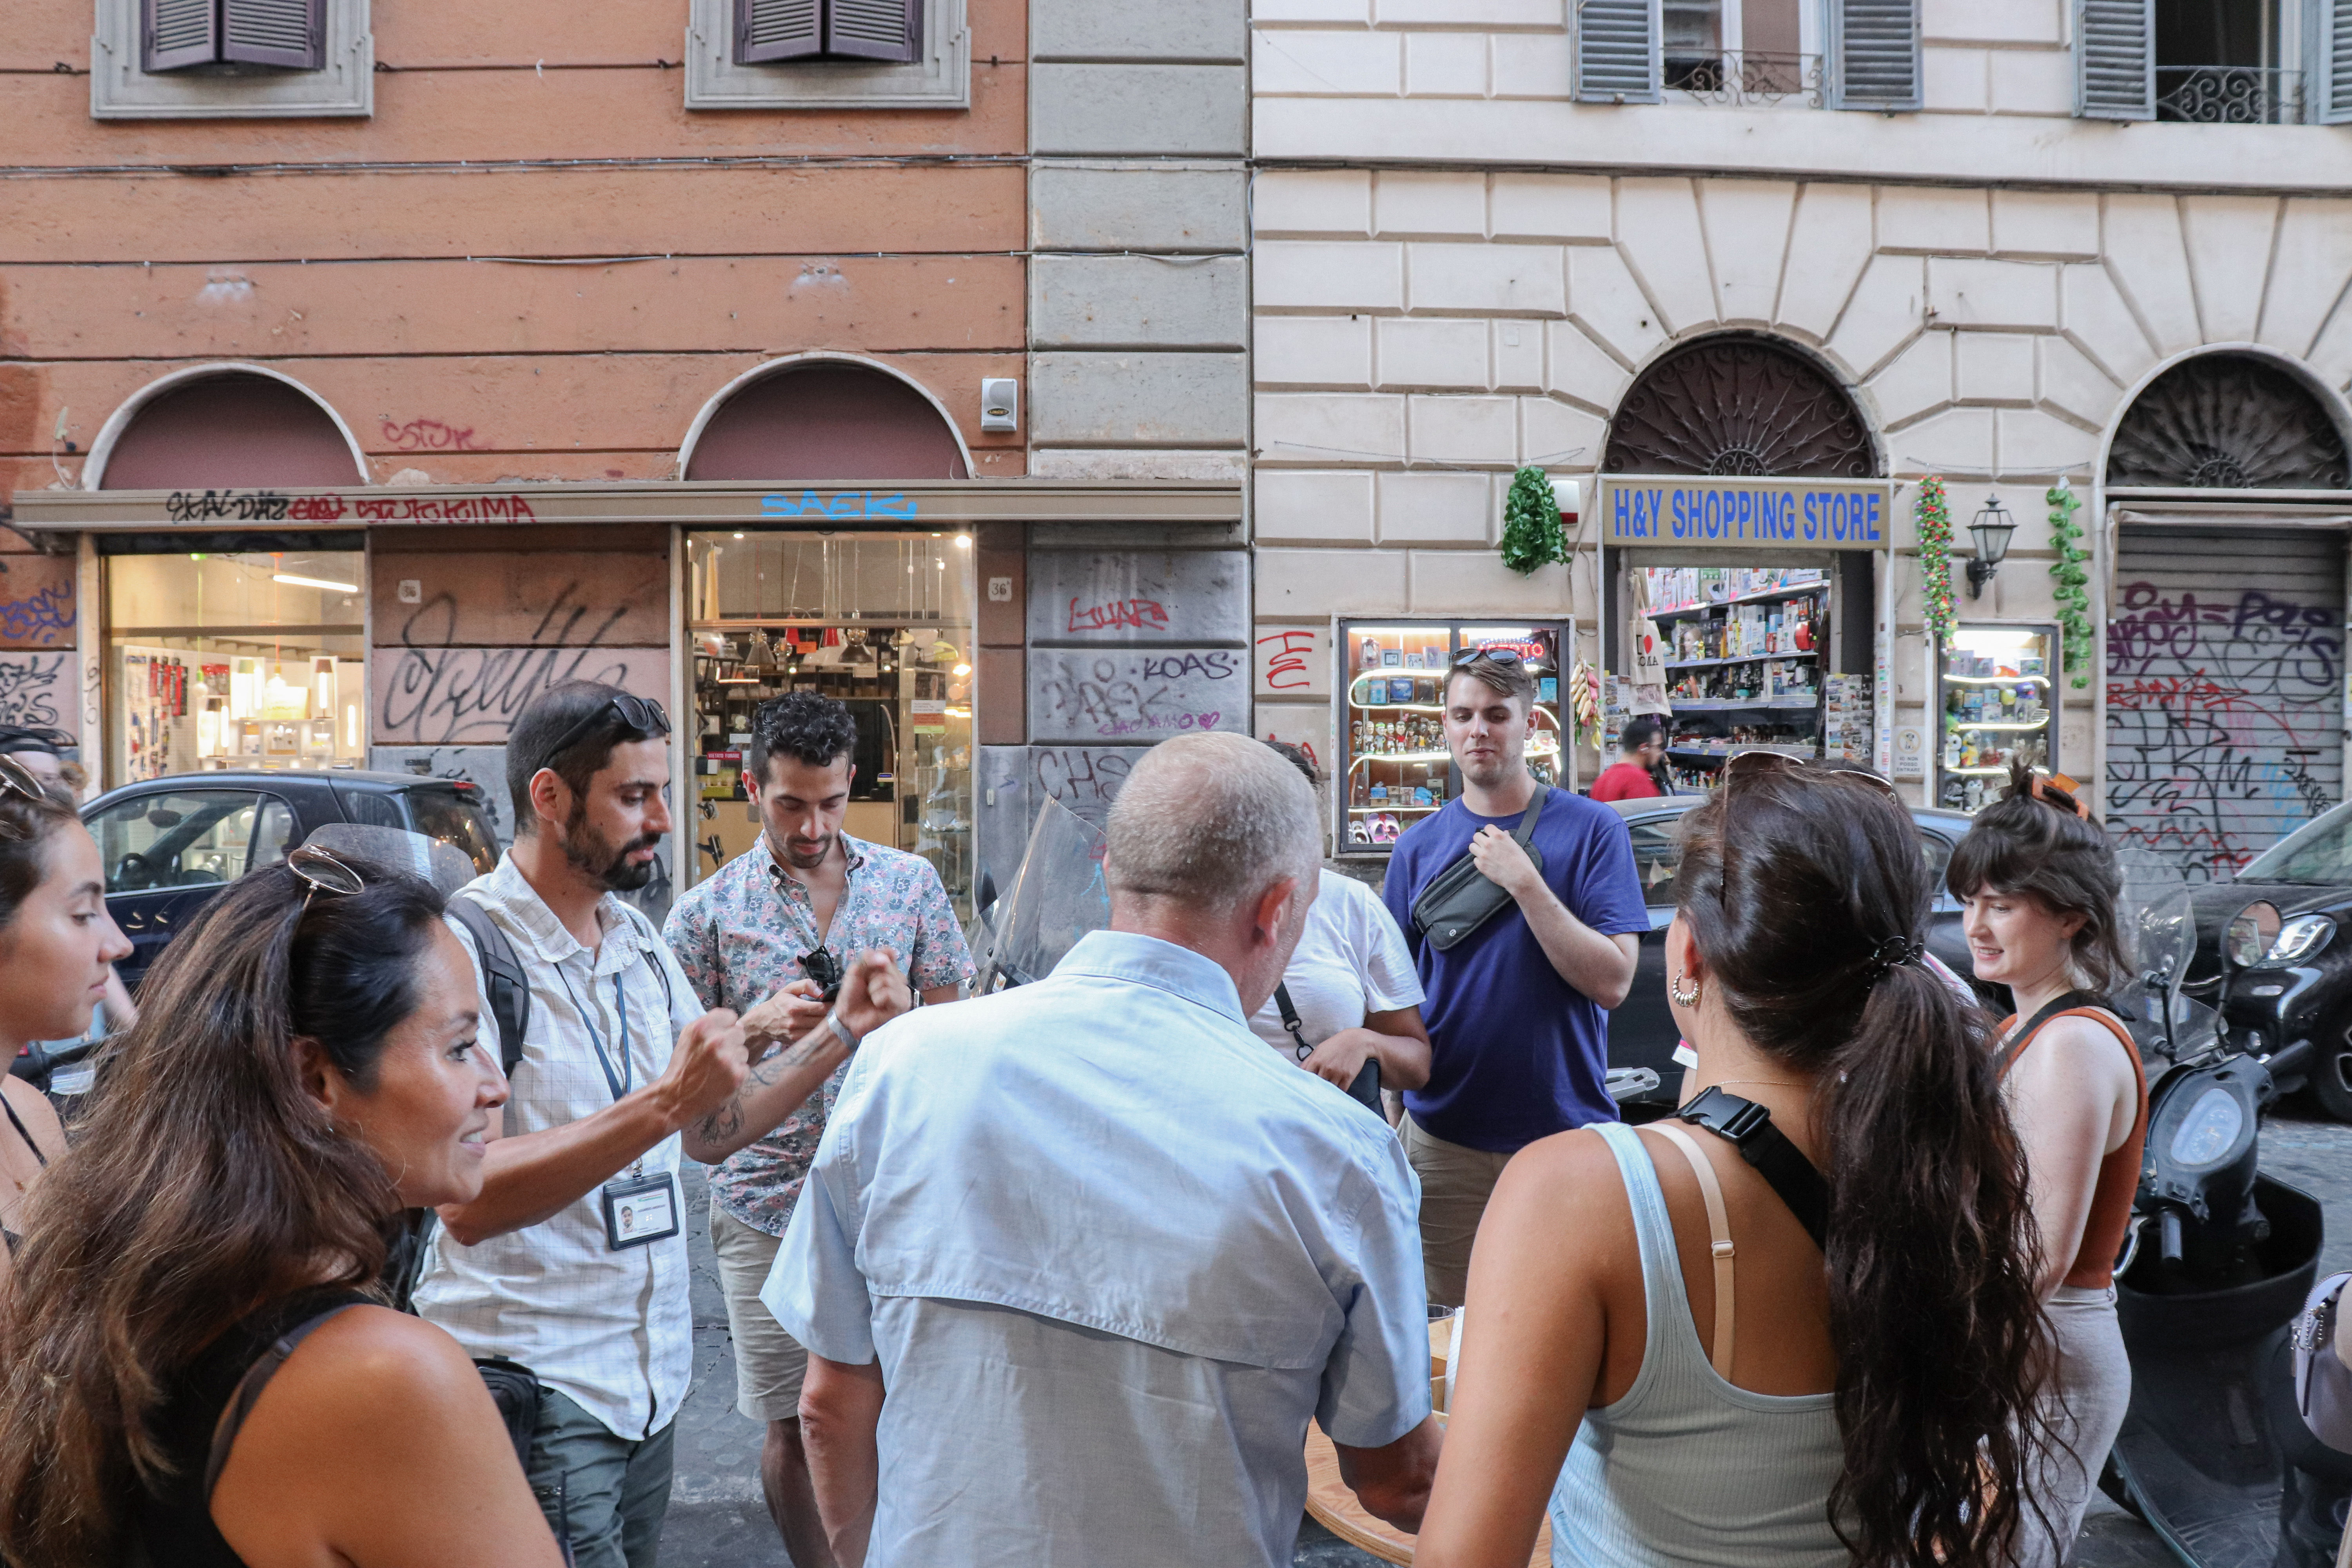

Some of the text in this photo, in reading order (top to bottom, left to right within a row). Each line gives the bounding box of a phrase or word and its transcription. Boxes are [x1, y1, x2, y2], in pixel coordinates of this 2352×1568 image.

[1615, 489, 1880, 541] H&Y SHOPPING STORE
[1638, 656, 1659, 666] OMA
